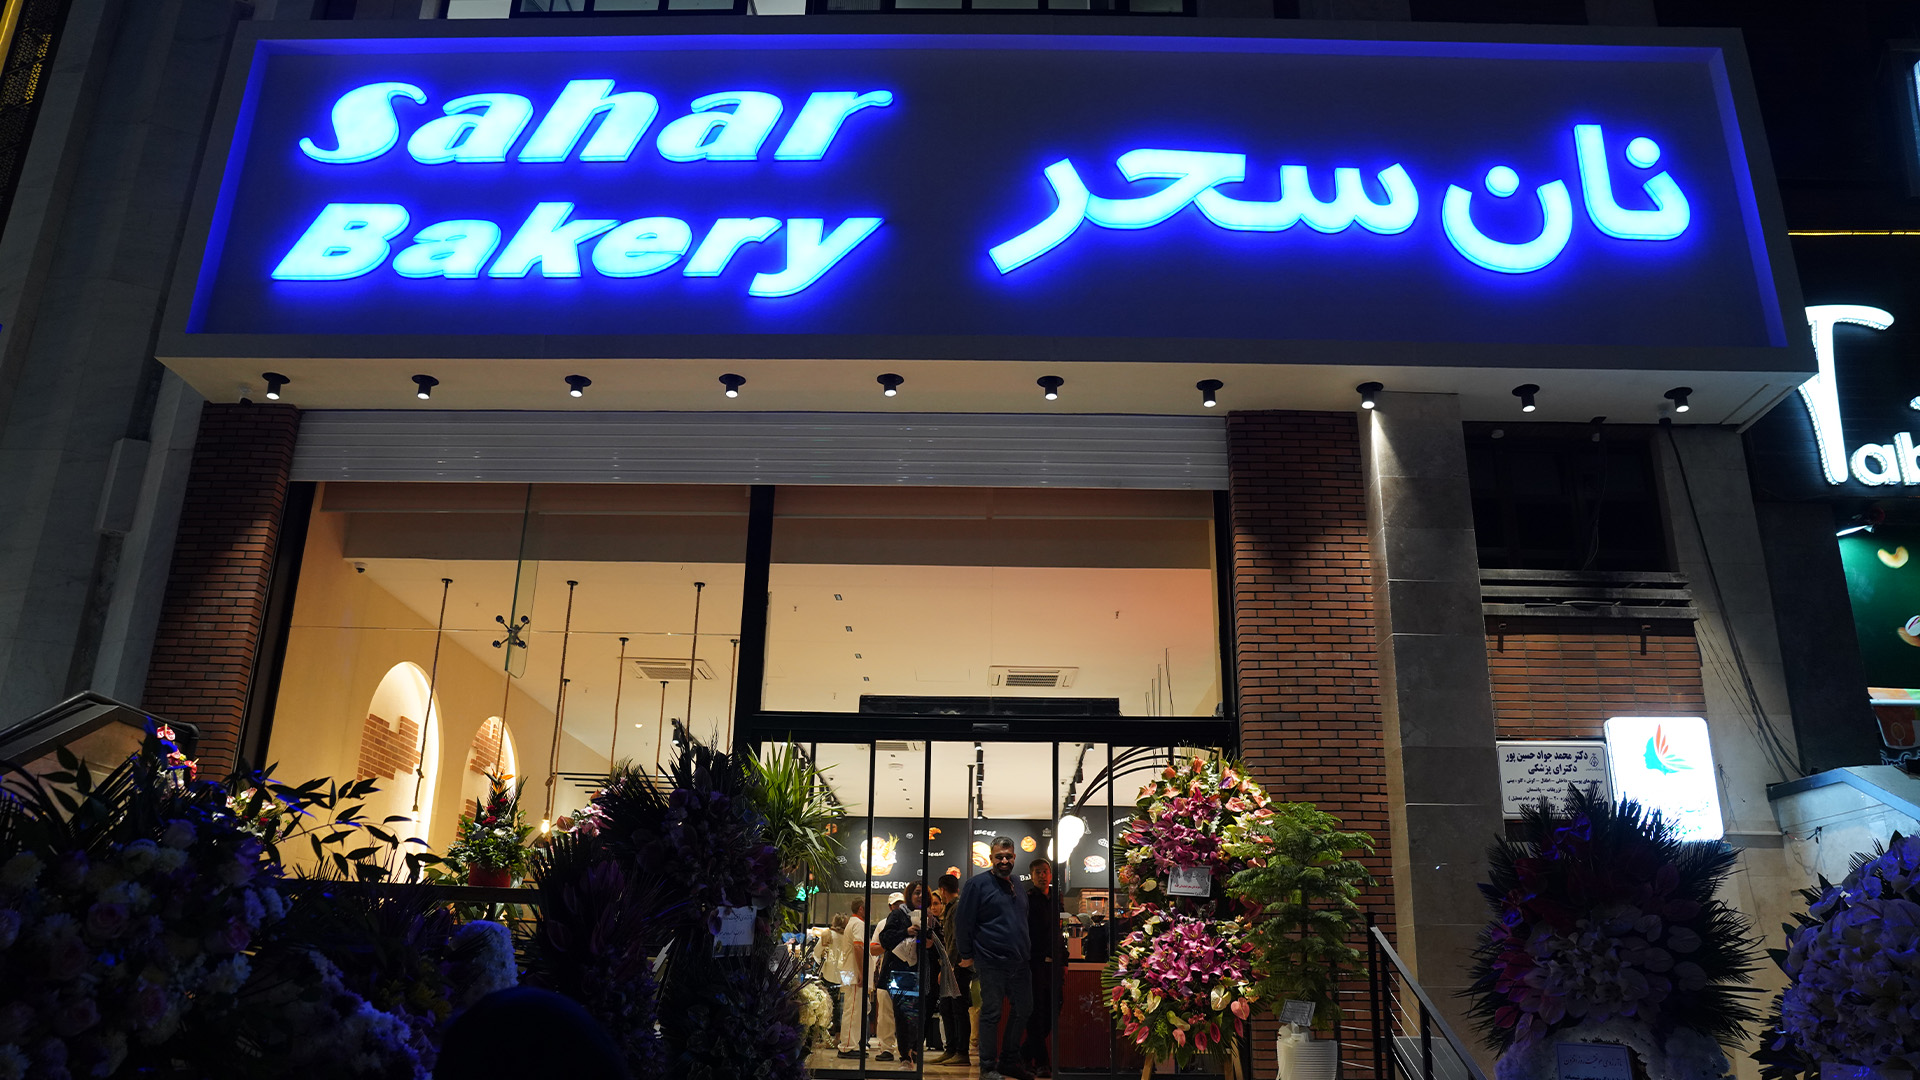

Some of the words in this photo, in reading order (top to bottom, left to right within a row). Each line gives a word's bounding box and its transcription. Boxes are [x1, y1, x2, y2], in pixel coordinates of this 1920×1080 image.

[298, 79, 894, 165] Sahar
[1442, 123, 1691, 274] نان
[988, 149, 1420, 275] سحر
[270, 202, 883, 299] Bakery
[1505, 752, 1516, 763] پور
[1516, 752, 1535, 762] حسین
[1536, 750, 1552, 763] جواد
[1554, 752, 1572, 760] محمد
[1574, 750, 1588, 763] دکتر
[1528, 763, 1552, 775] پزشکی
[1552, 763, 1578, 775] دکترای
[973, 829, 997, 837] weet
